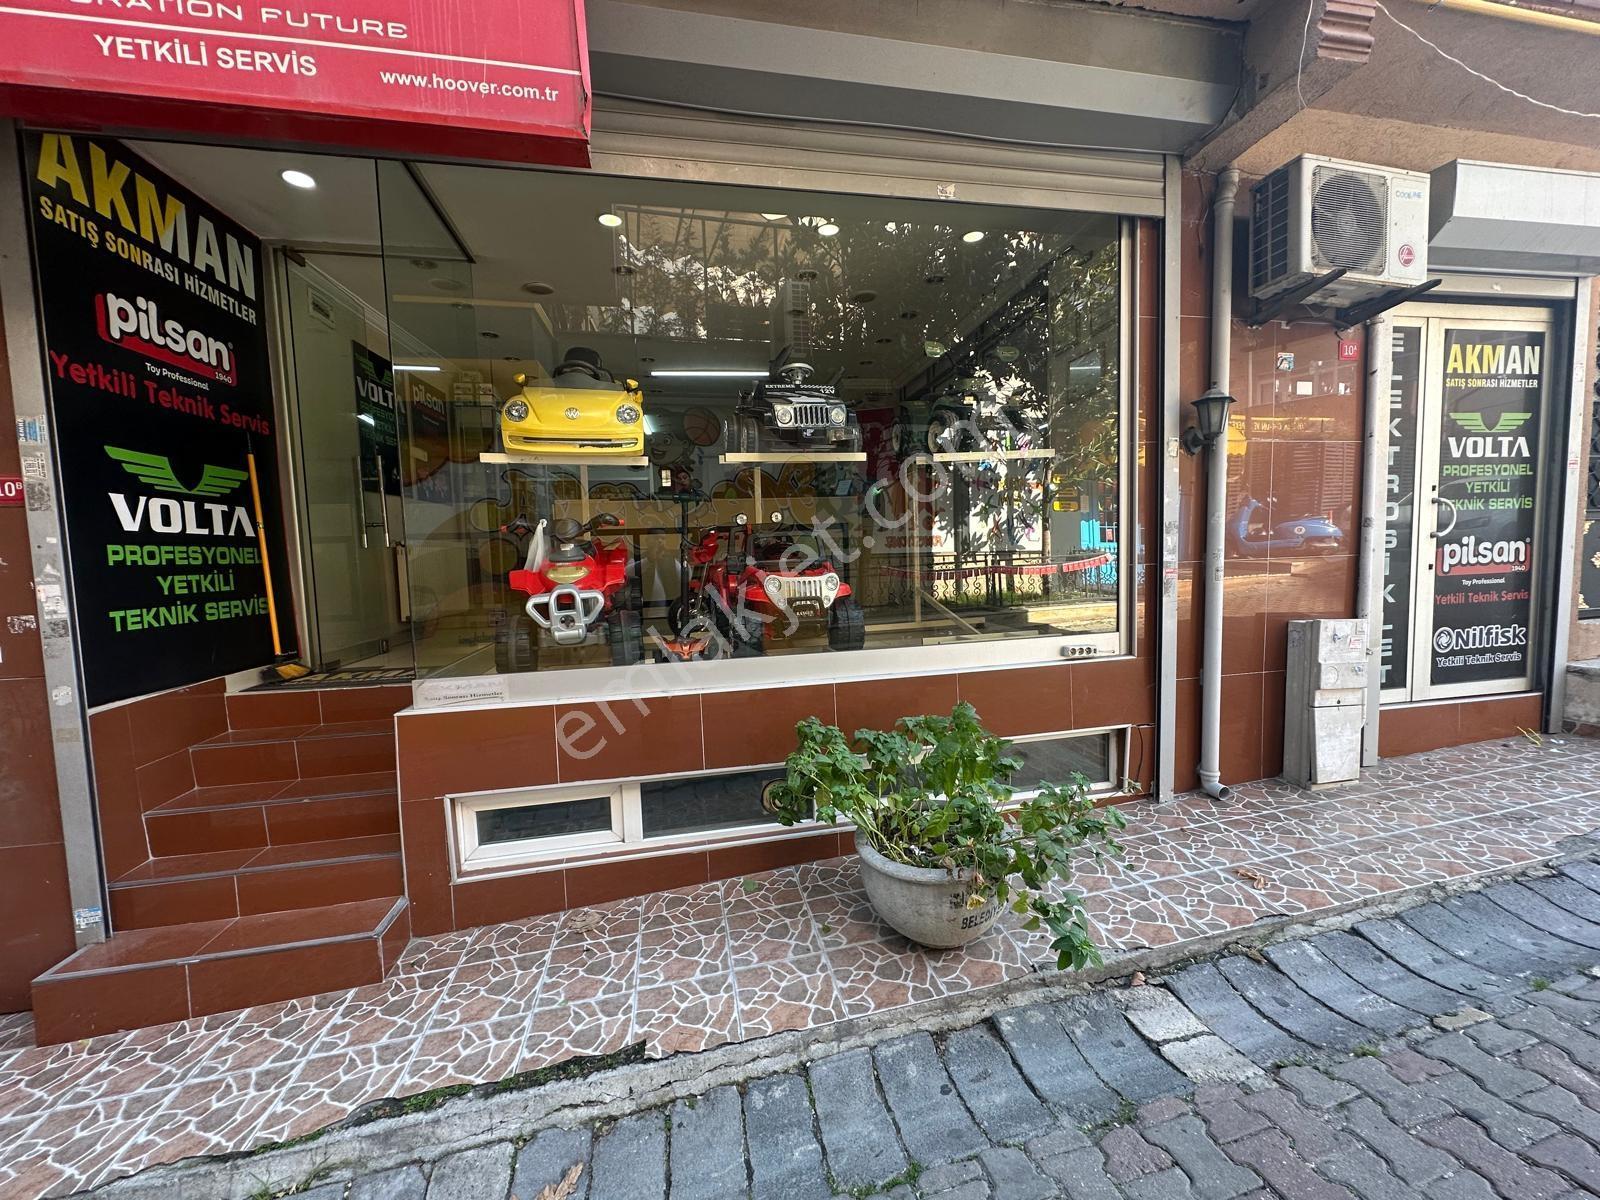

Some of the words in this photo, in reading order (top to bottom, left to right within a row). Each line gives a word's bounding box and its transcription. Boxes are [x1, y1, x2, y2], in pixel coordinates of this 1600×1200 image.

[261, 7, 408, 39] FUTURE
[93, 34, 208, 67] YETKİLİ
[216, 47, 317, 77] SERVİS
[380, 71, 559, 101] www.hoover.com.tr
[37, 133, 256, 301] AKMAN
[39, 195, 98, 248] SATIŞ
[105, 231, 180, 285] SONRASI
[184, 272, 257, 326] HİZMETLER
[106, 292, 230, 371] pilsan
[1446, 343, 1541, 375] AKMAN
[145, 362, 162, 376] Toy
[162, 368, 210, 391] Professional
[215, 371, 233, 385] 1940
[1446, 378, 1466, 390] SATIŞ
[1467, 378, 1498, 388] SONRASI
[1499, 376, 1538, 388] HİZMETLER
[50, 350, 136, 399] Yetkili
[144, 380, 215, 420] Teknik
[220, 404, 271, 436] Servis
[1448, 436, 1530, 458] VOLTA
[1443, 464, 1533, 477] PROFESYONEL
[1466, 478, 1511, 493] YETKİLİ
[108, 492, 256, 537] VOLTA
[1488, 495, 1533, 510] SERVİS
[106, 544, 263, 566] PROFESYONEL
[1443, 535, 1526, 573] pilsan
[156, 569, 235, 595] YETKİLİ
[1472, 577, 1506, 585] Professional
[1435, 592, 1465, 605] Yetkili
[1468, 591, 1499, 603] Teknik
[1501, 589, 1529, 600] Servis
[109, 601, 199, 632] TEKNİK
[205, 594, 269, 620] SERVİS
[1453, 624, 1527, 650] Nilfisk
[1436, 655, 1464, 668] Yetkili
[1465, 652, 1494, 665] Teknik
[1495, 651, 1521, 662] Servis
